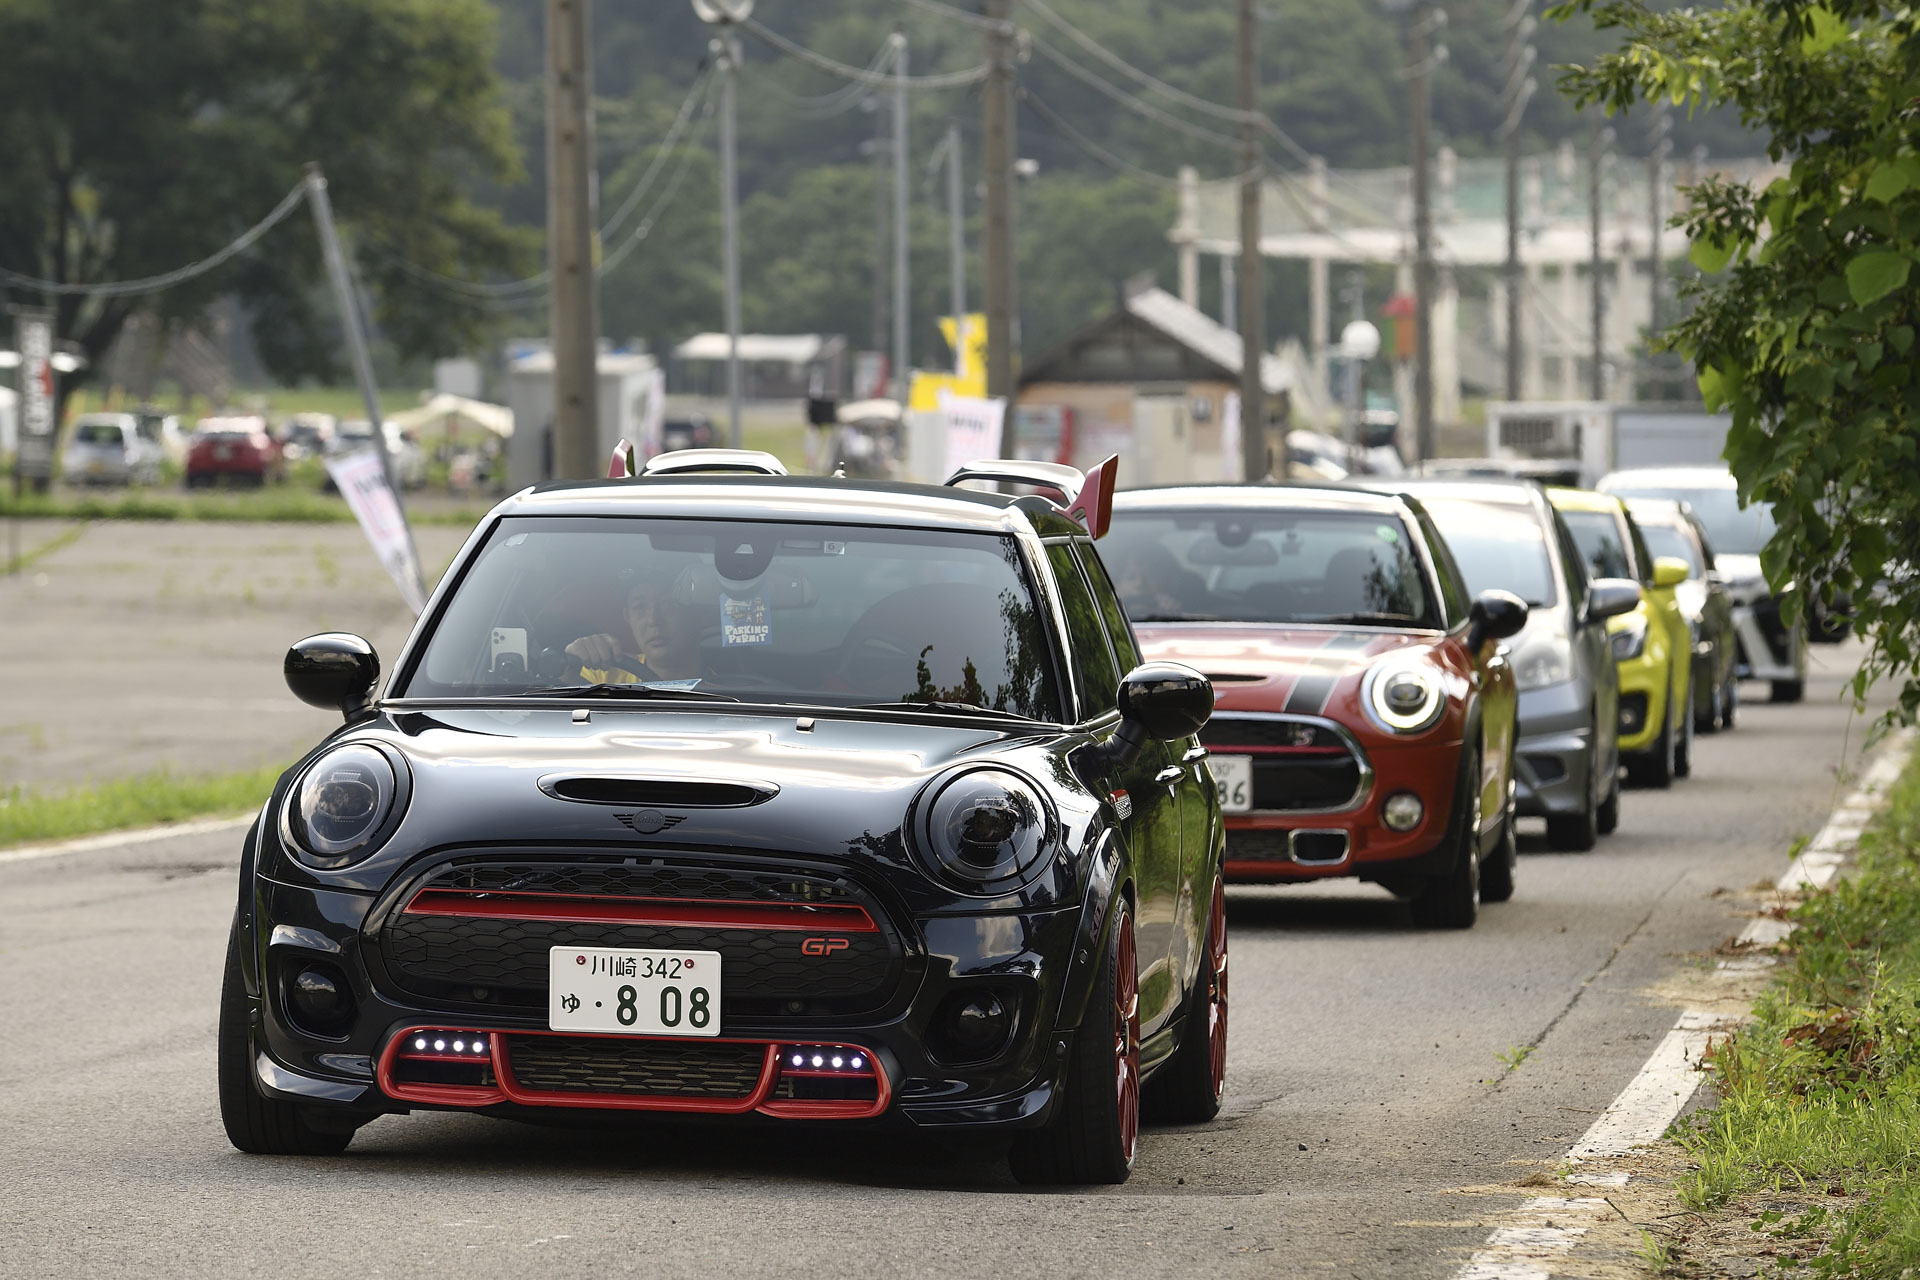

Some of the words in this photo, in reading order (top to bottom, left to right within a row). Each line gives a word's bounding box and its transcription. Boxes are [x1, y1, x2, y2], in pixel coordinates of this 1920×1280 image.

[725, 625, 768, 635] PARKING
[728, 633, 766, 643] PERMIT
[1217, 780, 1246, 805] 86
[801, 937, 849, 956] GP
[560, 993, 581, 1014] ゆ
